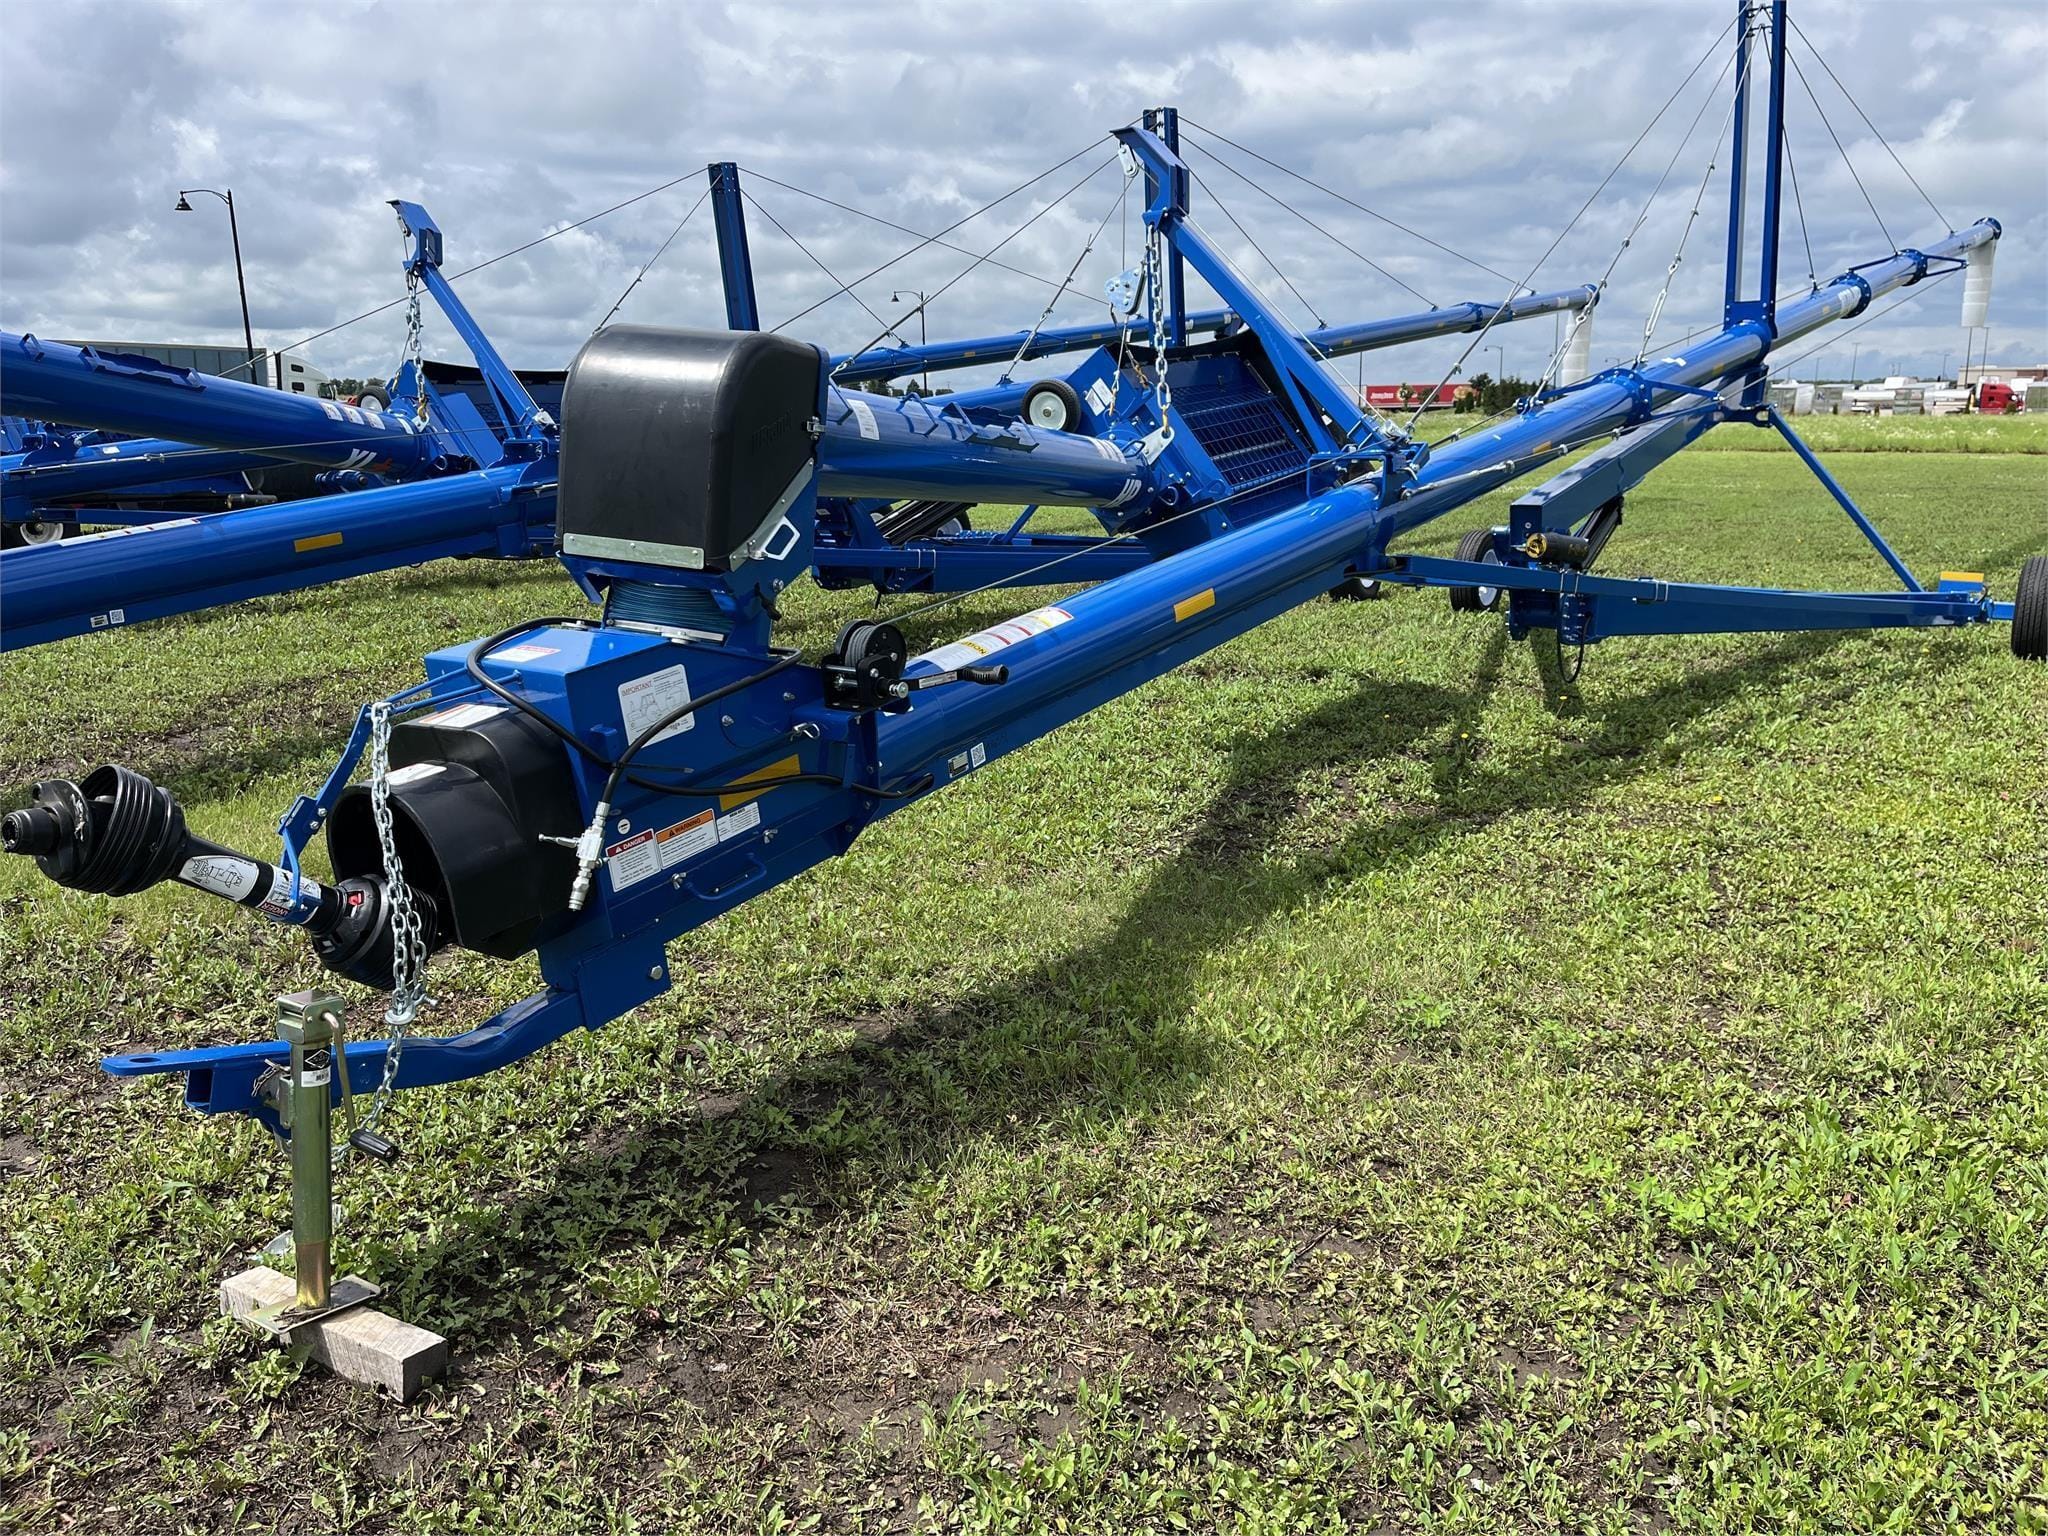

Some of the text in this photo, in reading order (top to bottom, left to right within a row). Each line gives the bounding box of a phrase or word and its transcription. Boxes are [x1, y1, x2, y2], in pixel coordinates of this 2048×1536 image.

[621, 680, 652, 697] IMPORTANT
[674, 817, 702, 833] WARNING
[622, 835, 646, 850] DANGER
